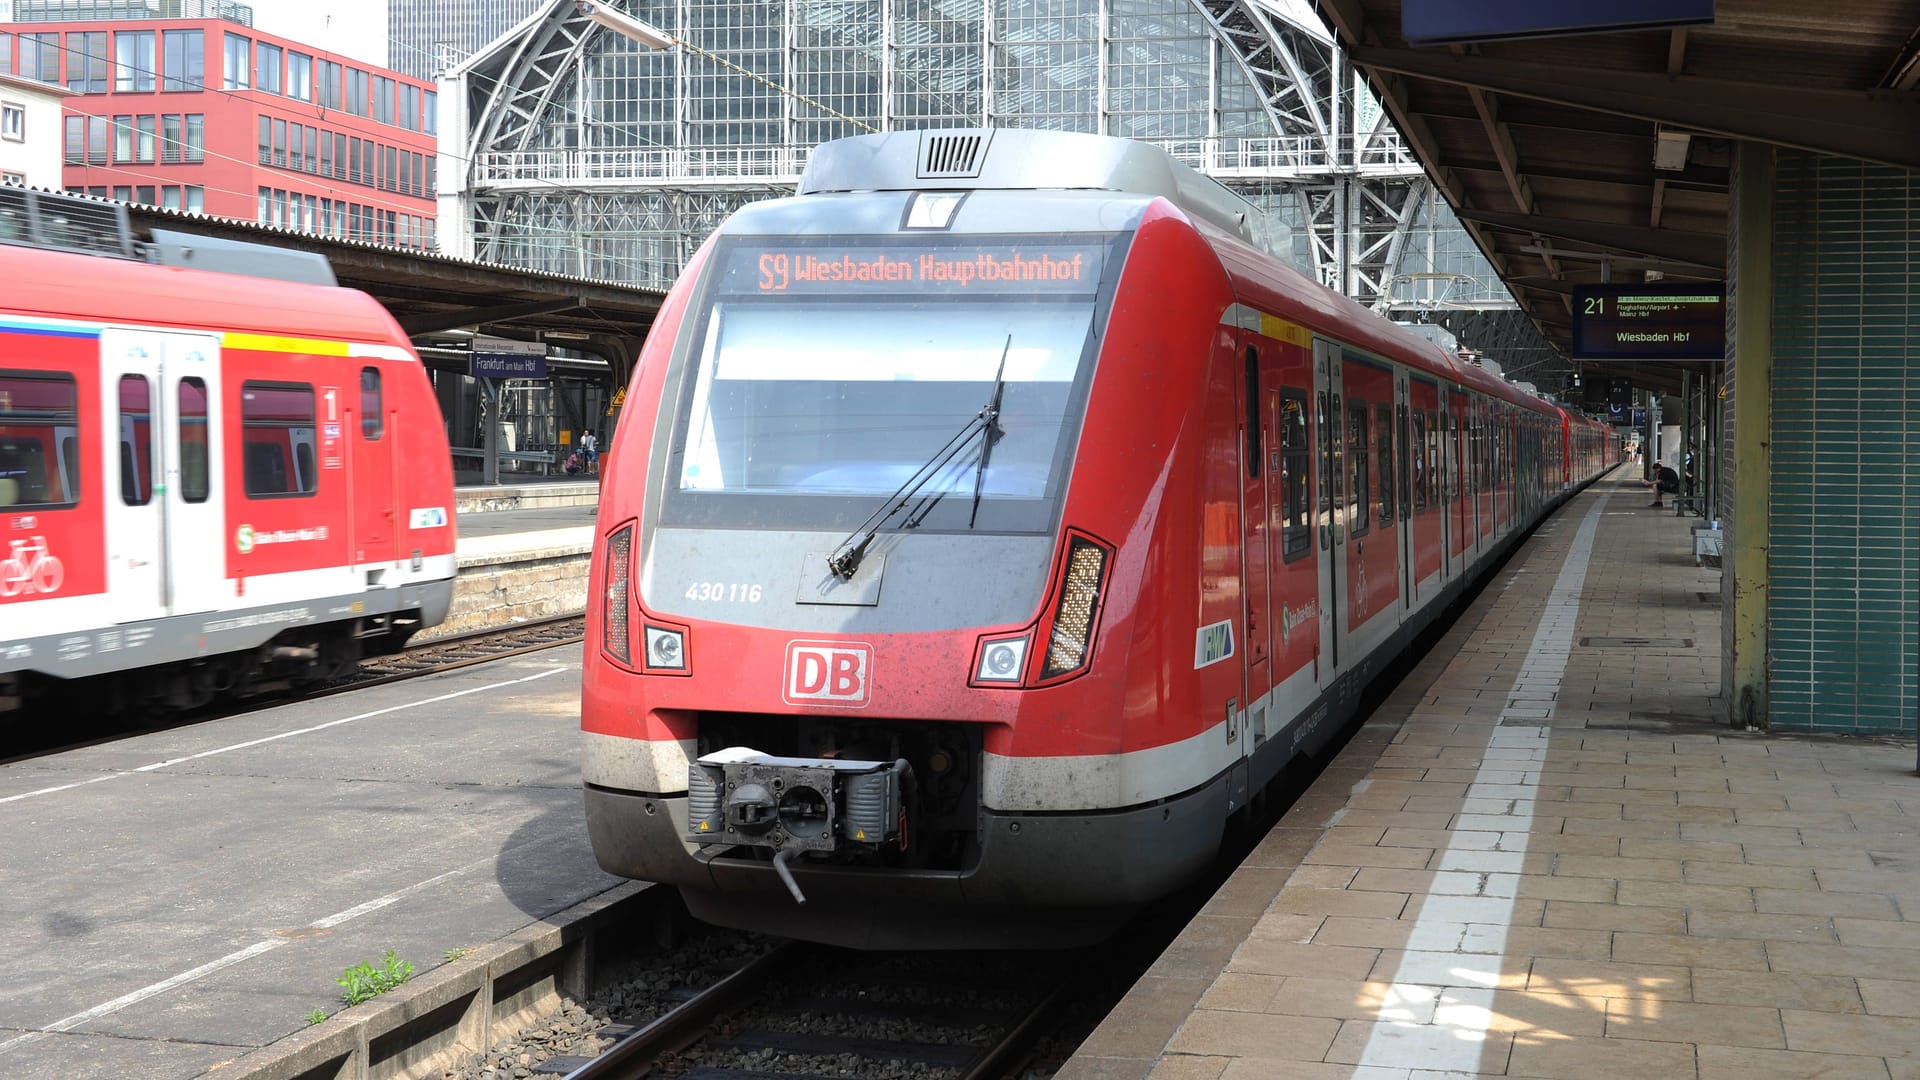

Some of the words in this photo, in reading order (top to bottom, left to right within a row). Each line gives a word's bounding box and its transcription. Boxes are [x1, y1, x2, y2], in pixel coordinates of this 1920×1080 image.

[758, 253, 789, 291] S9
[794, 255, 912, 281] Wiesbaden
[919, 252, 1083, 286] Hauptbahnhof
[1584, 297, 1604, 315] 21
[1616, 304, 1671, 312] Flughafen/Airport
[1616, 332, 1669, 342] Wiesbaden
[1673, 332, 1690, 342] Hbf
[476, 357, 505, 370] Frankfurt
[513, 362, 524, 371] Main
[525, 360, 536, 371] Hbf
[324, 390, 336, 420] 1
[685, 581, 724, 602] 430
[729, 583, 763, 602] 116
[794, 650, 862, 697] DB
